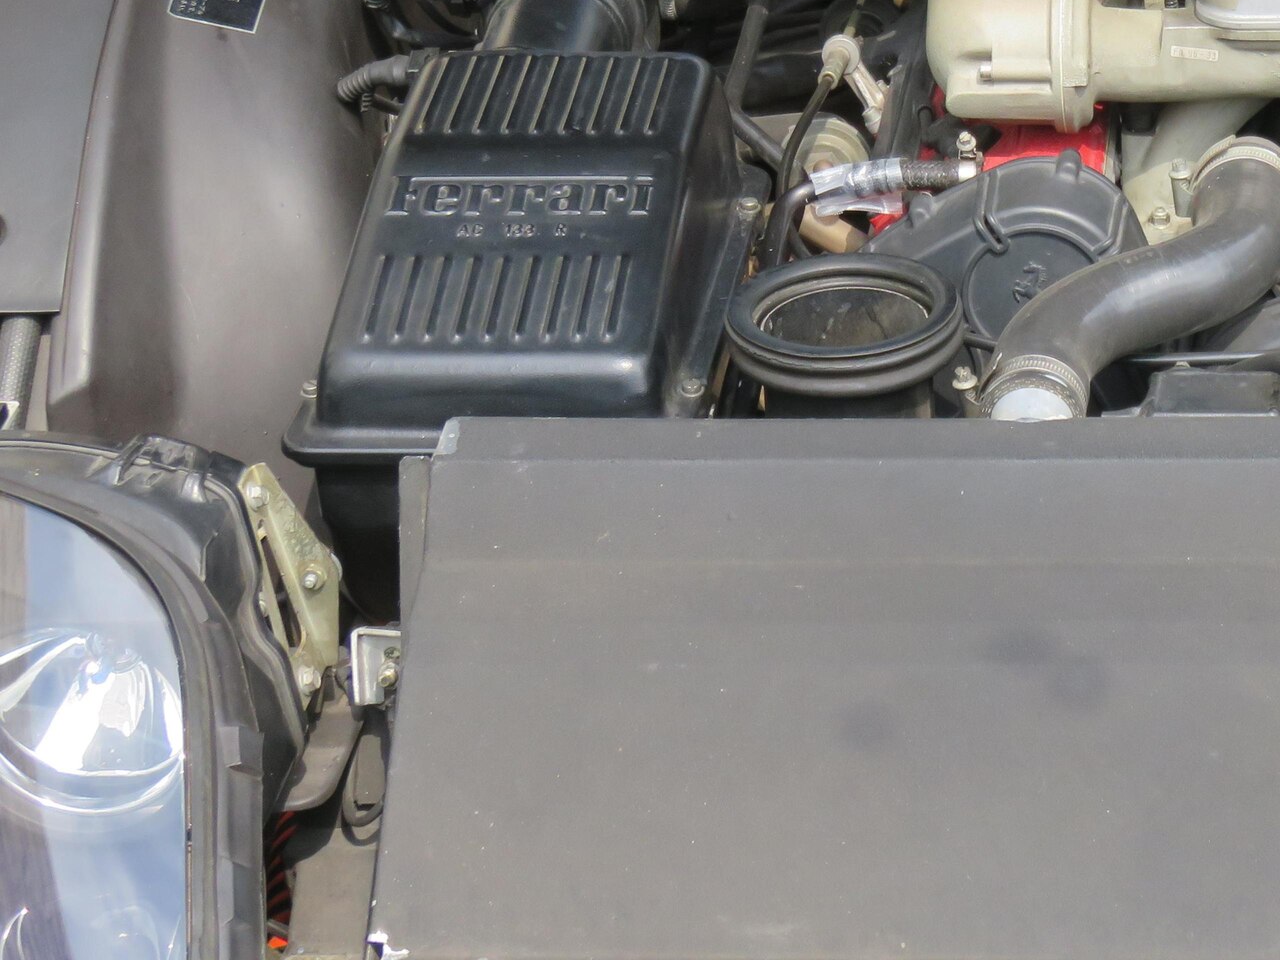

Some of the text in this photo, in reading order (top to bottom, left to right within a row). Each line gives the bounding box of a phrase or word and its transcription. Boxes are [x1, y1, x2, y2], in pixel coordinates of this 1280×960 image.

[384, 175, 654, 216] Ferrari
[456, 222, 568, 238] AC 133 R
